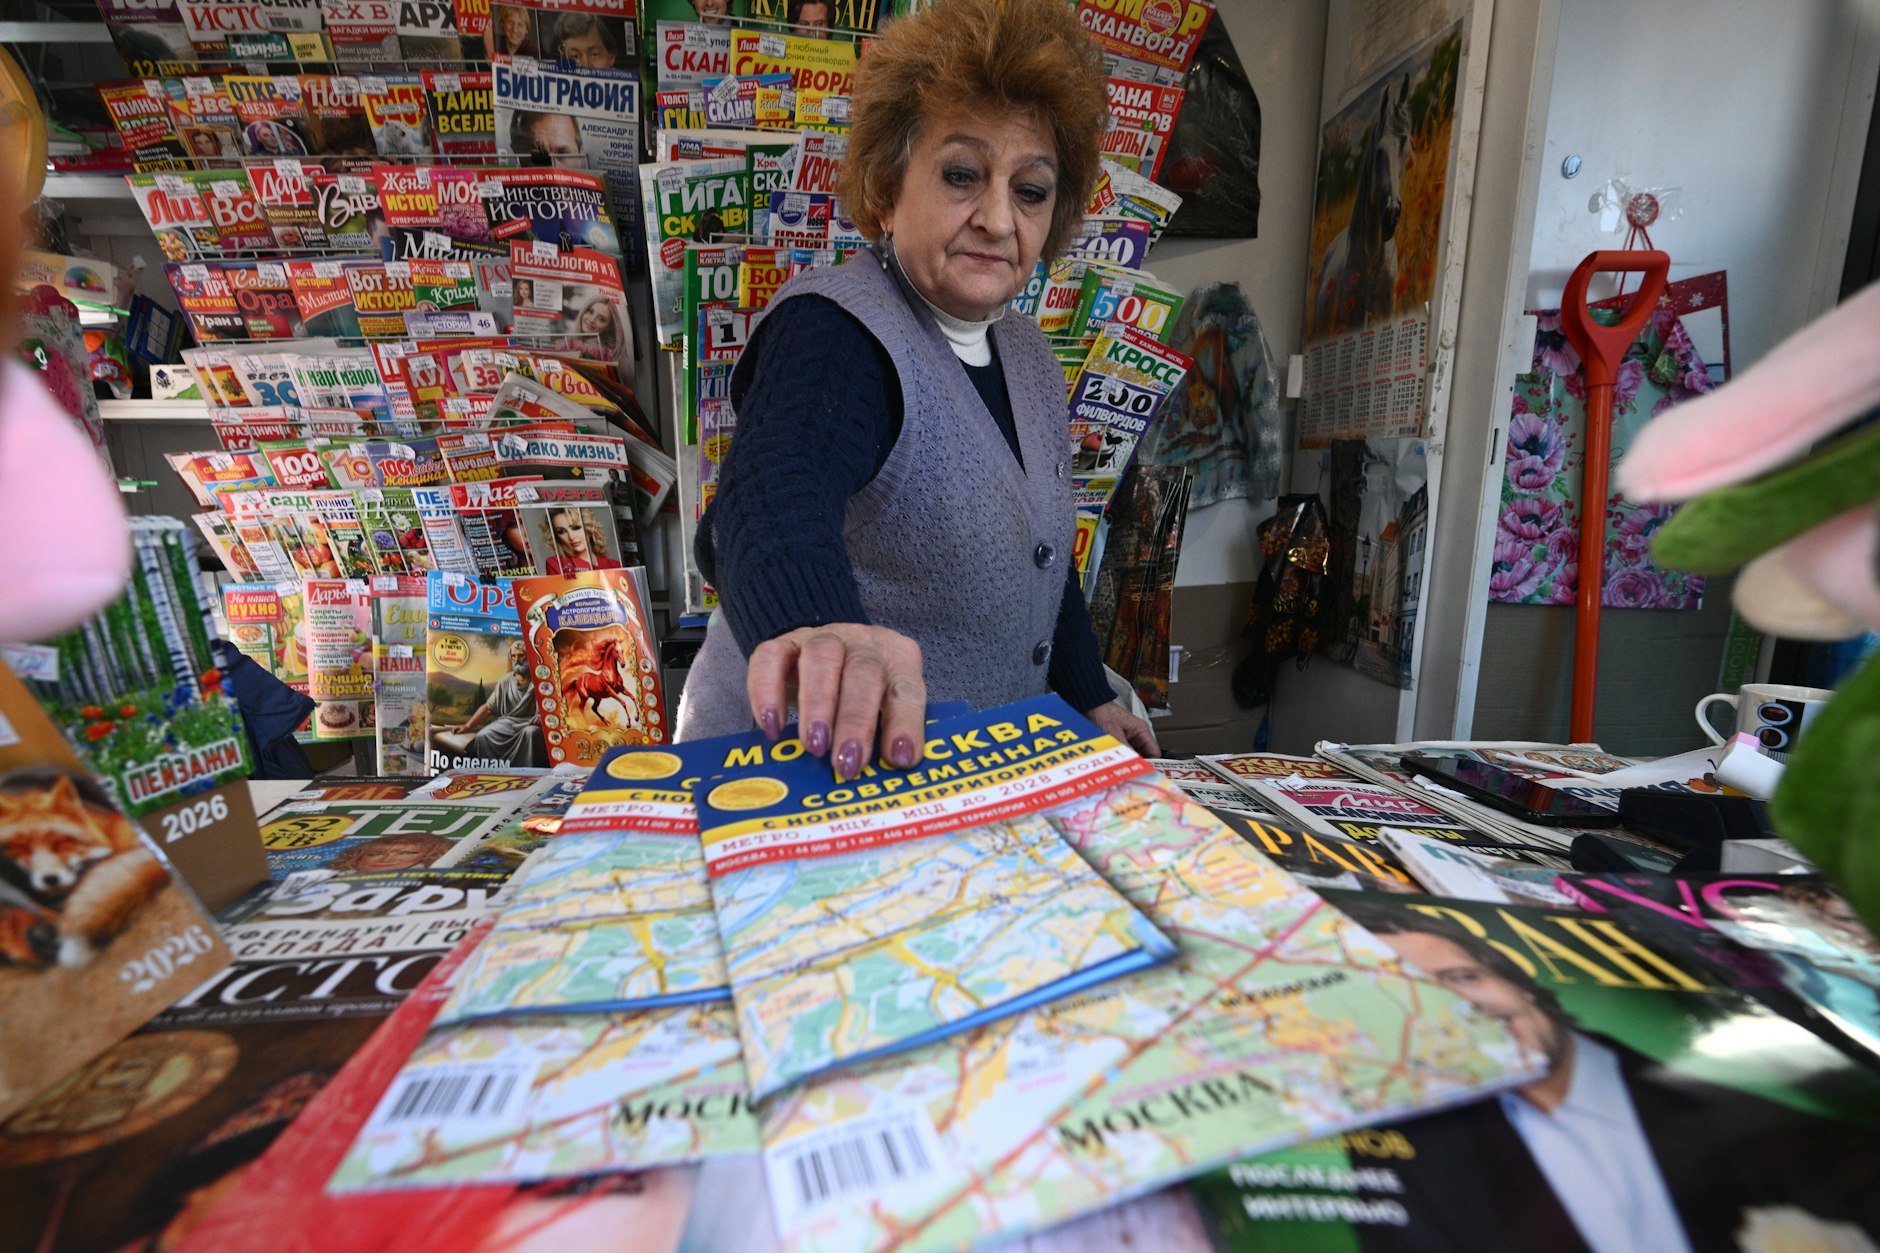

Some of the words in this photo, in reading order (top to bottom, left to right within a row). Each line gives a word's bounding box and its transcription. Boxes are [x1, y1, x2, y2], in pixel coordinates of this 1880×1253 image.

[331, 26, 368, 34] ЗАГАДКИ
[1080, 9, 1190, 64] СКАНВОРД
[793, 44, 829, 54] любимый
[496, 66, 634, 113] БИОГРАФИЯ
[582, 124, 627, 137] АЛЕКСАНДР
[604, 150, 633, 159] ЧУРСИН
[610, 142, 633, 150] ЮРИЙ
[680, 142, 700, 150] УМА
[660, 177, 744, 215] ГИГА
[489, 200, 597, 222] ИСТОРИИ
[514, 247, 599, 273] Психология
[608, 265, 616, 279] Я
[1094, 292, 1167, 331] 500
[197, 315, 232, 328] Уран
[477, 319, 491, 327] 46
[1108, 341, 1181, 386] КРОСС
[1394, 373, 1416, 382] ДЕКАБРЬ
[1076, 403, 1146, 432] ФИЛВОРДОВ
[564, 443, 622, 462] жизнь!
[377, 459, 415, 477] 1001
[249, 593, 276, 603] нашей
[310, 588, 350, 605] Дарья
[230, 601, 277, 615] кухне
[379, 656, 423, 672] НАША
[313, 673, 373, 685] Лучшие
[314, 686, 323, 694] к
[834, 712, 1063, 785] СКВА
[430, 750, 449, 768] По
[452, 753, 511, 770] следам
[801, 729, 1080, 808] СОВРЕМЕННАЯ
[128, 743, 240, 799] ПЕЙЗАЖИ
[763, 820, 776, 829] С
[788, 799, 902, 827] НОВЫМИ
[915, 743, 1096, 803] ТЕРРИТОРИЯМИ
[161, 794, 228, 843] 2026
[722, 831, 812, 853] МЕТРО,
[902, 803, 947, 820] МЦД
[1001, 775, 1052, 796] 2028
[715, 851, 768, 871] МОСКВА
[1058, 1071, 1275, 1154] МОСКВА
